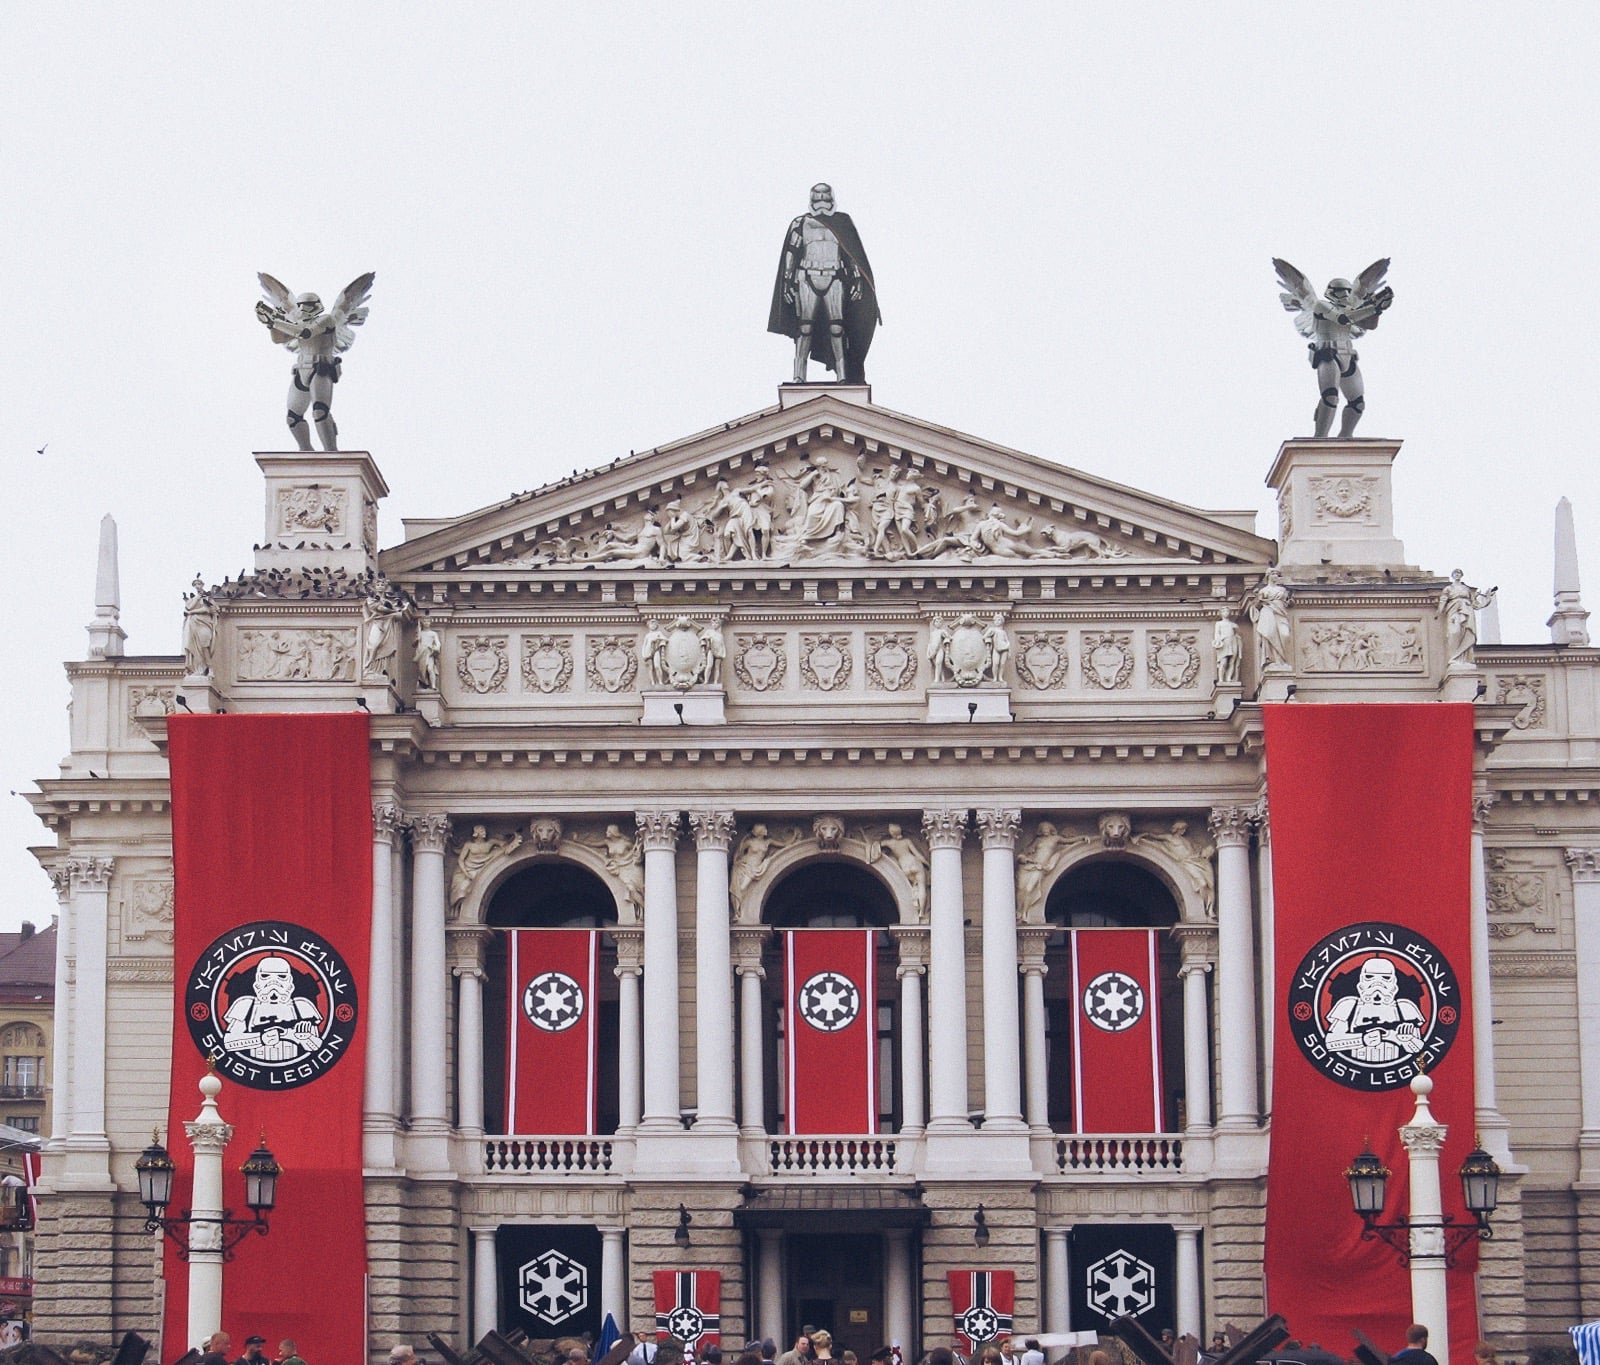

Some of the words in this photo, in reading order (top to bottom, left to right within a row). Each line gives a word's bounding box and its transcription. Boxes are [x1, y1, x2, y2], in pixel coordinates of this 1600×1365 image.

[202, 1034, 261, 1081] 501ST
[270, 1034, 343, 1084] LEGION
[1304, 1033, 1361, 1081] 501ST
